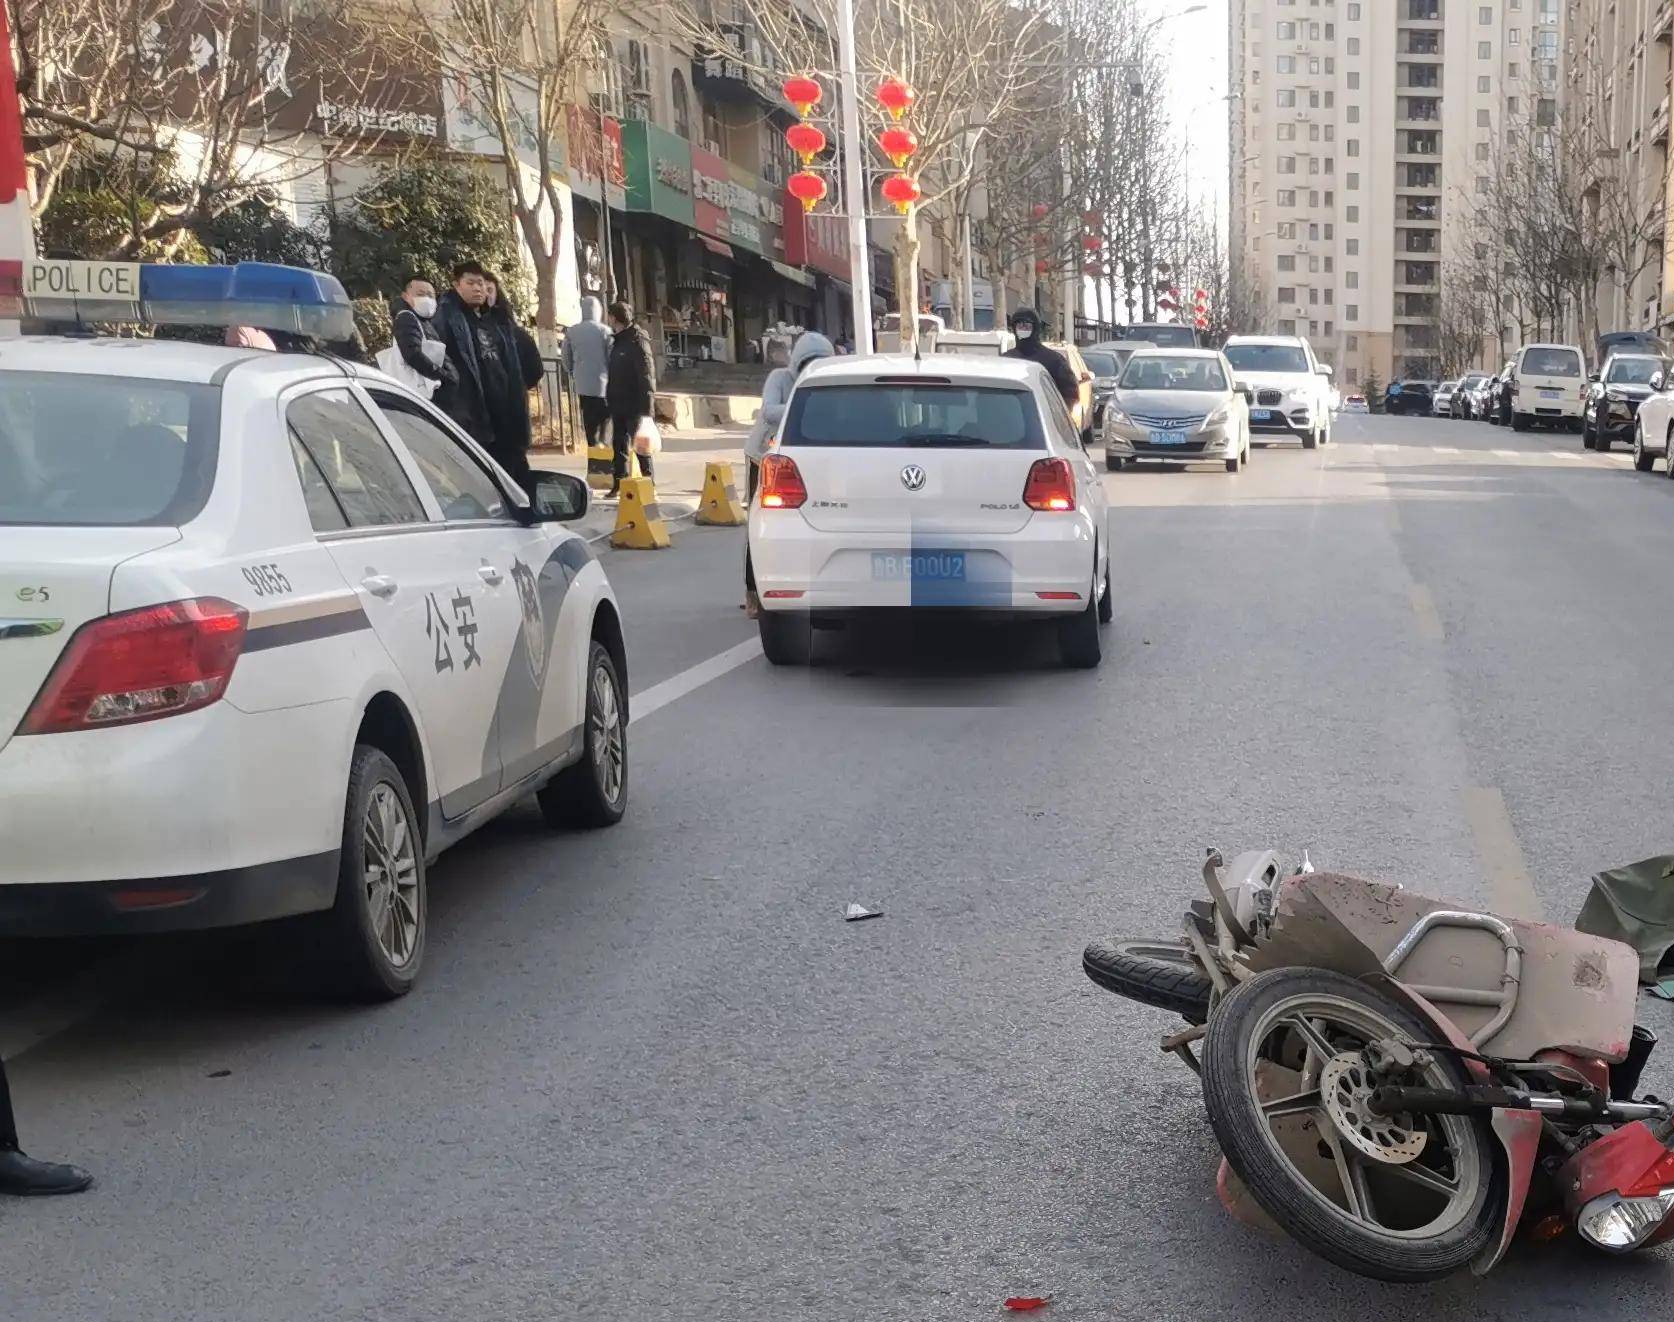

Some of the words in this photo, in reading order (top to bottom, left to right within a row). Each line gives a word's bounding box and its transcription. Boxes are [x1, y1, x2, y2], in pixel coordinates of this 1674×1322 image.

[32, 265, 130, 294] POLICE
[241, 563, 293, 597] 9855
[425, 586, 481, 674] 公安
